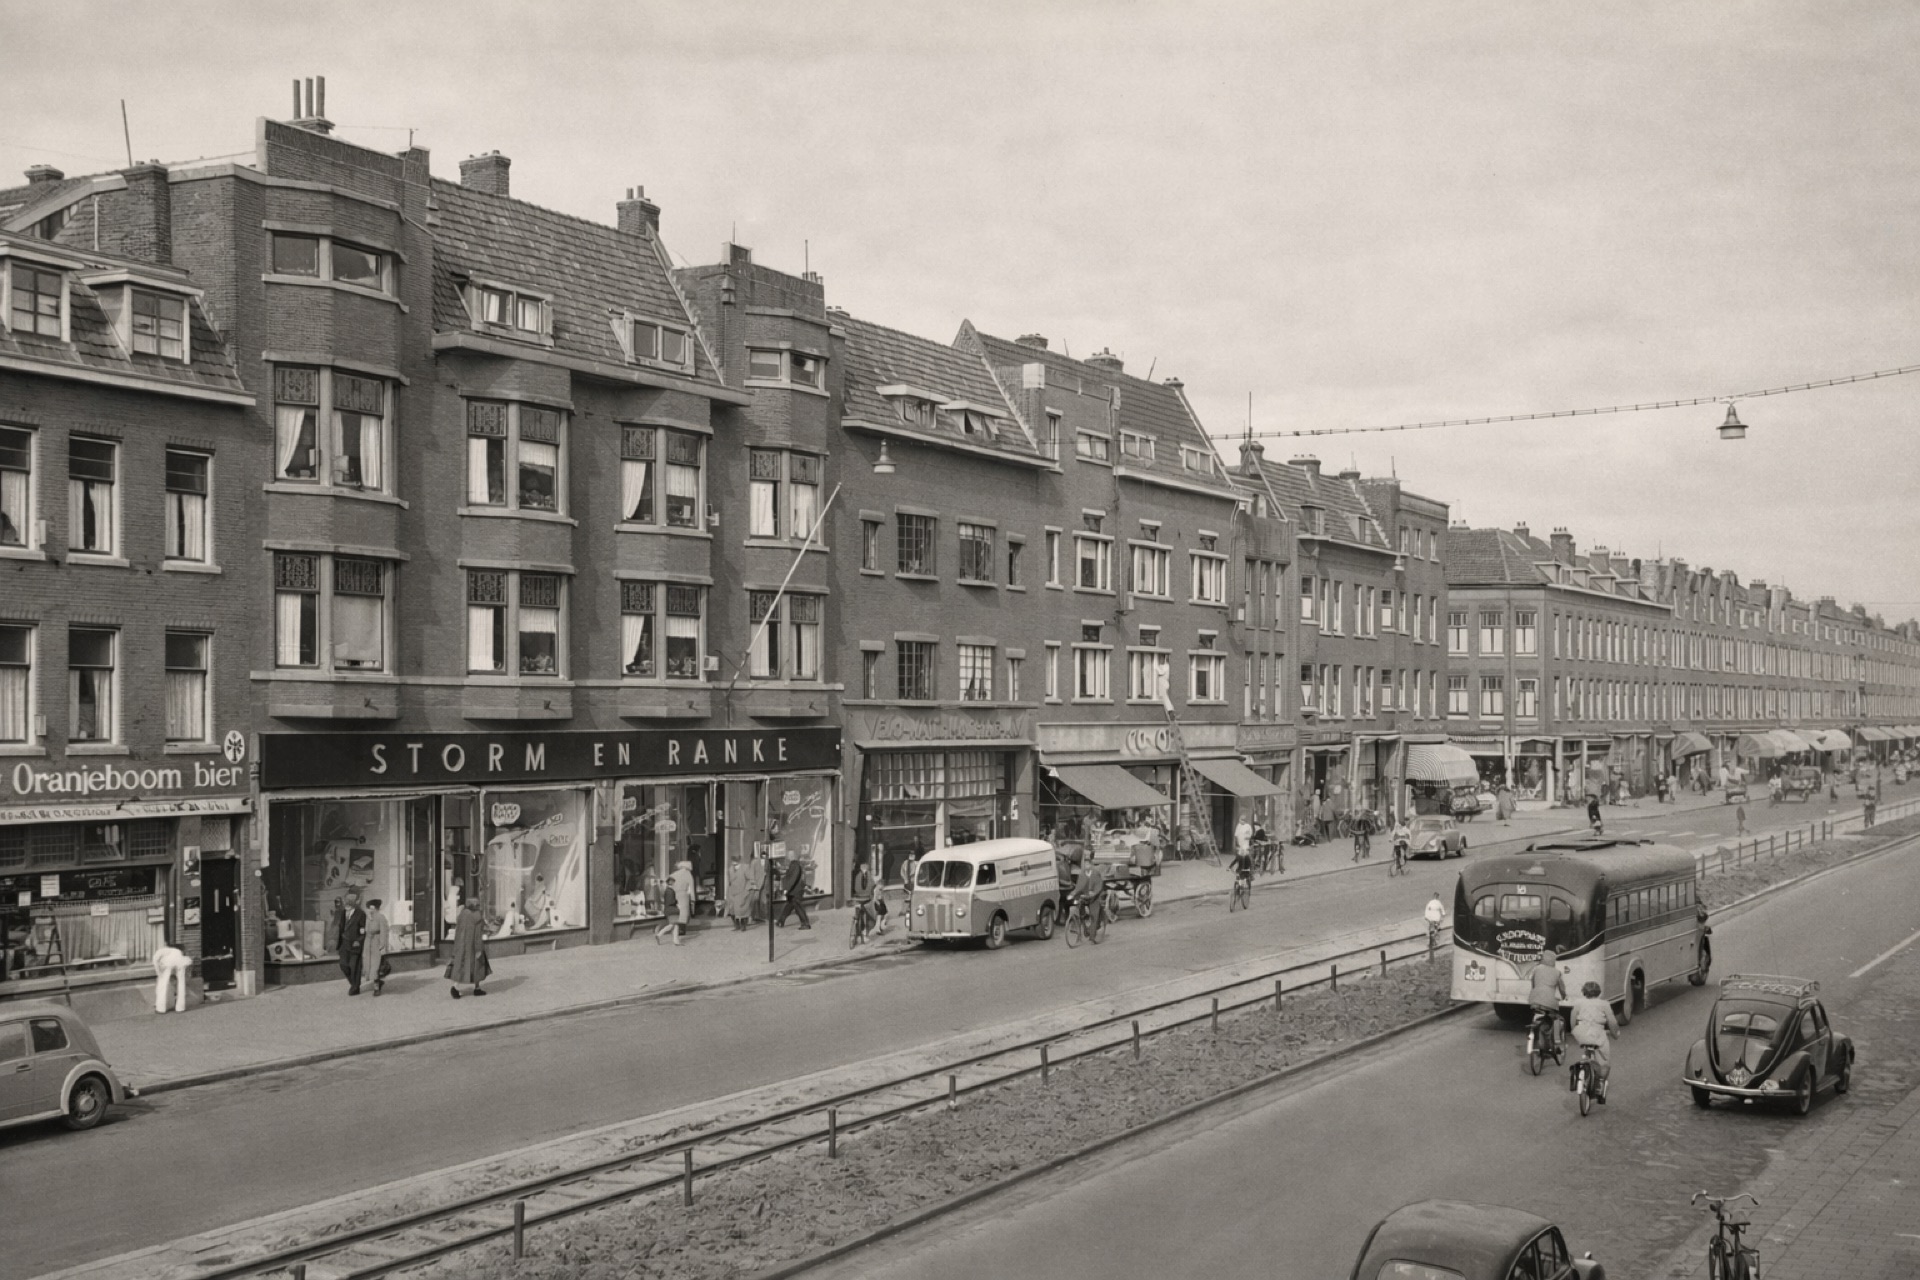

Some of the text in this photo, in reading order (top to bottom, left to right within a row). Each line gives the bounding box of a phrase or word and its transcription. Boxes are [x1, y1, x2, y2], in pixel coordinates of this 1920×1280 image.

[370, 738, 787, 774] STORM EN RANKE
[13, 763, 181, 795] Oranjeboom
[194, 761, 243, 787] bier
